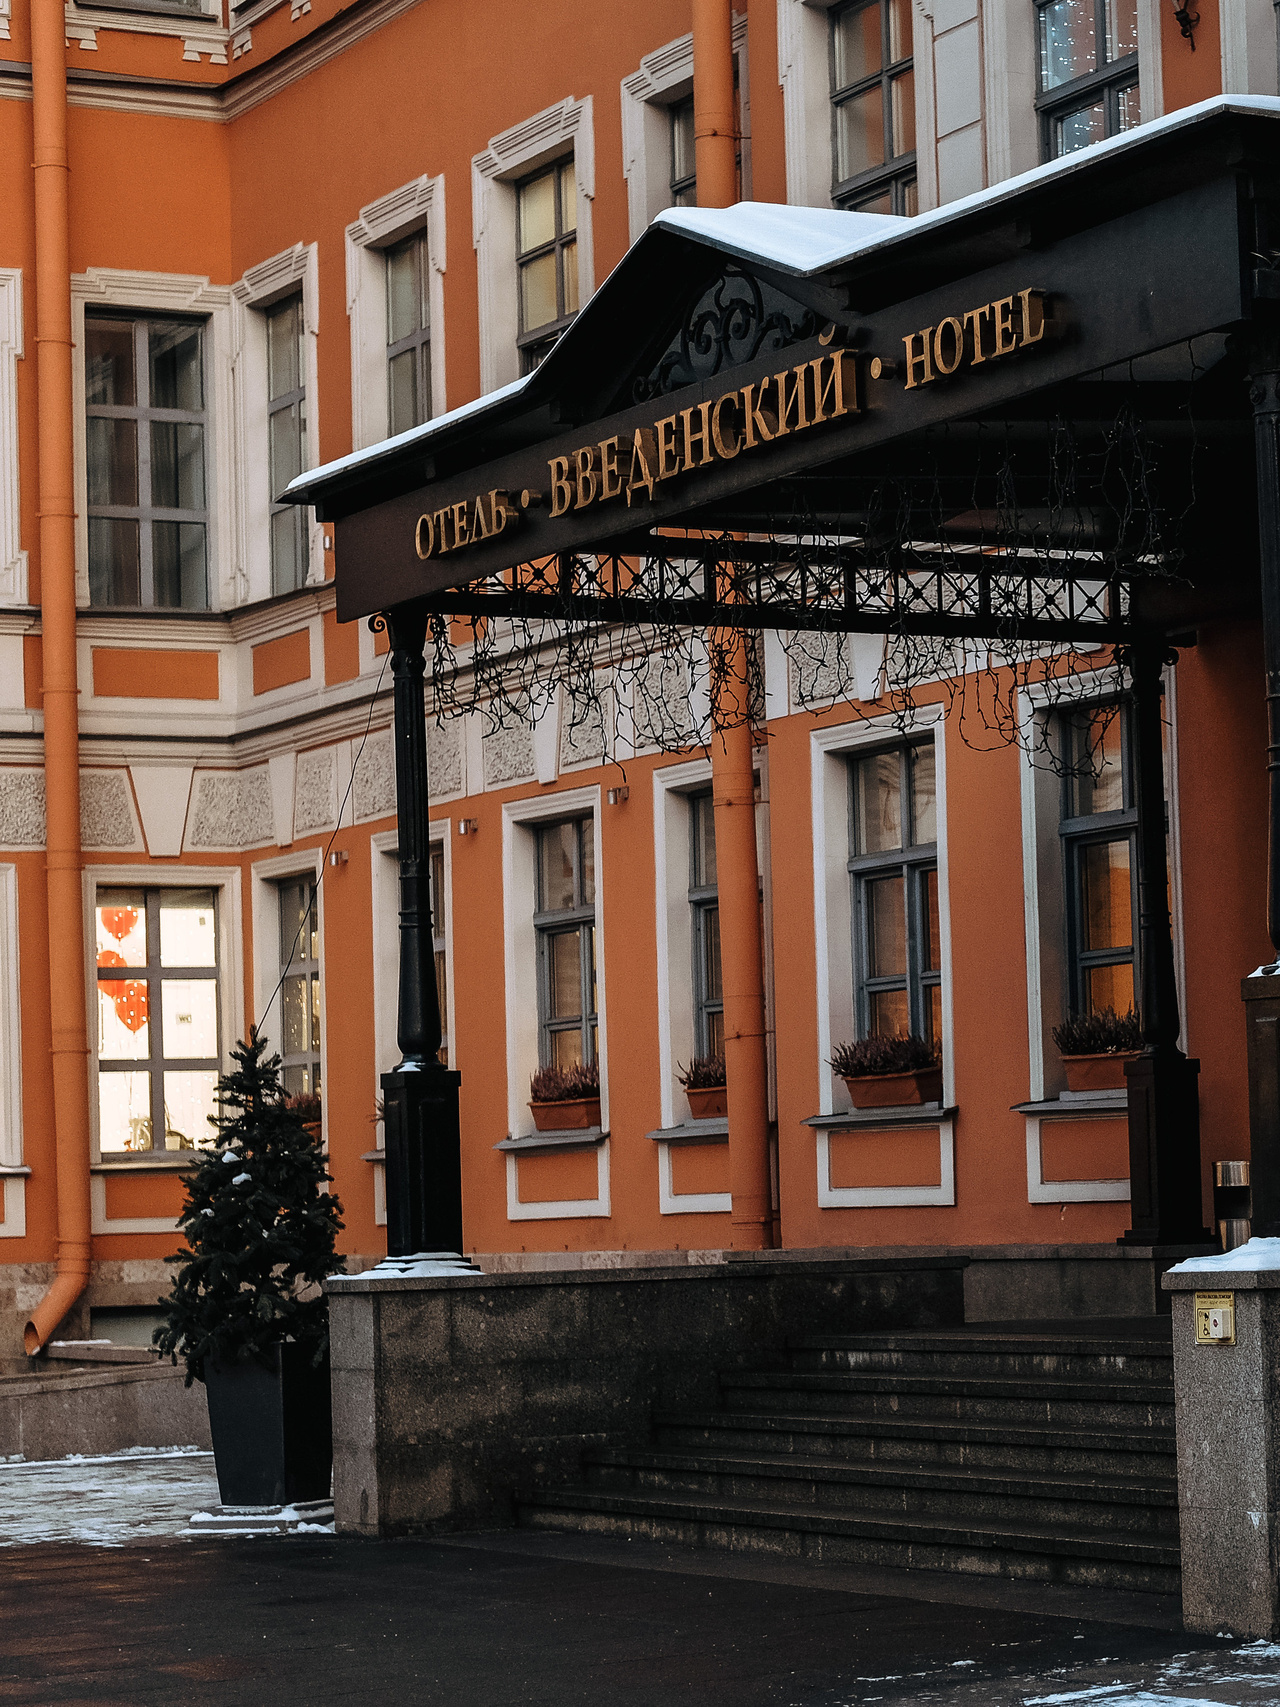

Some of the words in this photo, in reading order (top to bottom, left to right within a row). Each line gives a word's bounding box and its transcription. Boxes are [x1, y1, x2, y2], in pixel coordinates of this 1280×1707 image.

[415, 488, 508, 560] ОТЕЛЬ
[547, 323, 849, 519] ВВЕДЕНСКИЙ
[902, 287, 1045, 390] HOTEL
